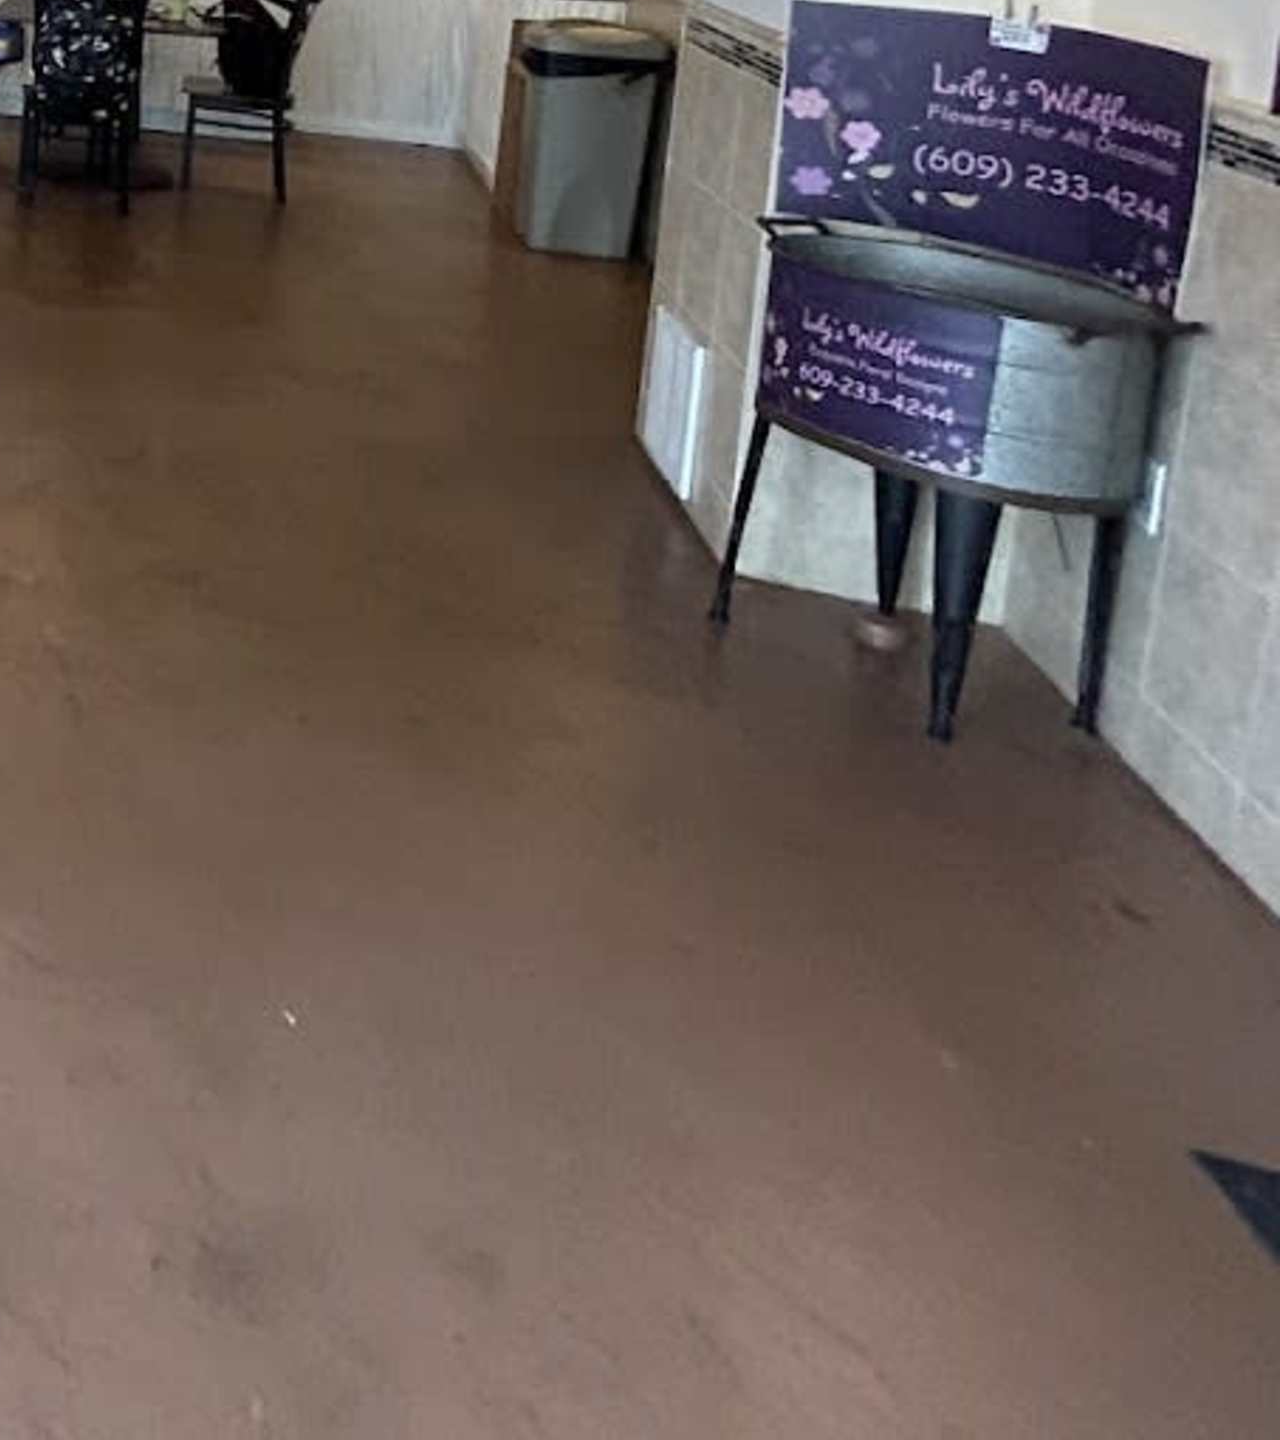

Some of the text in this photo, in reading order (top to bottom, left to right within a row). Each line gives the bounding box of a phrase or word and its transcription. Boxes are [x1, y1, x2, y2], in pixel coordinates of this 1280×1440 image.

[926, 103, 1013, 132] Flowers
[1019, 116, 1058, 140] For
[1061, 130, 1090, 148] All
[932, 62, 1184, 148] Lily's Wildflowers
[912, 143, 1172, 231] (609) 233-4244
[799, 364, 955, 426] 609-233-4244
